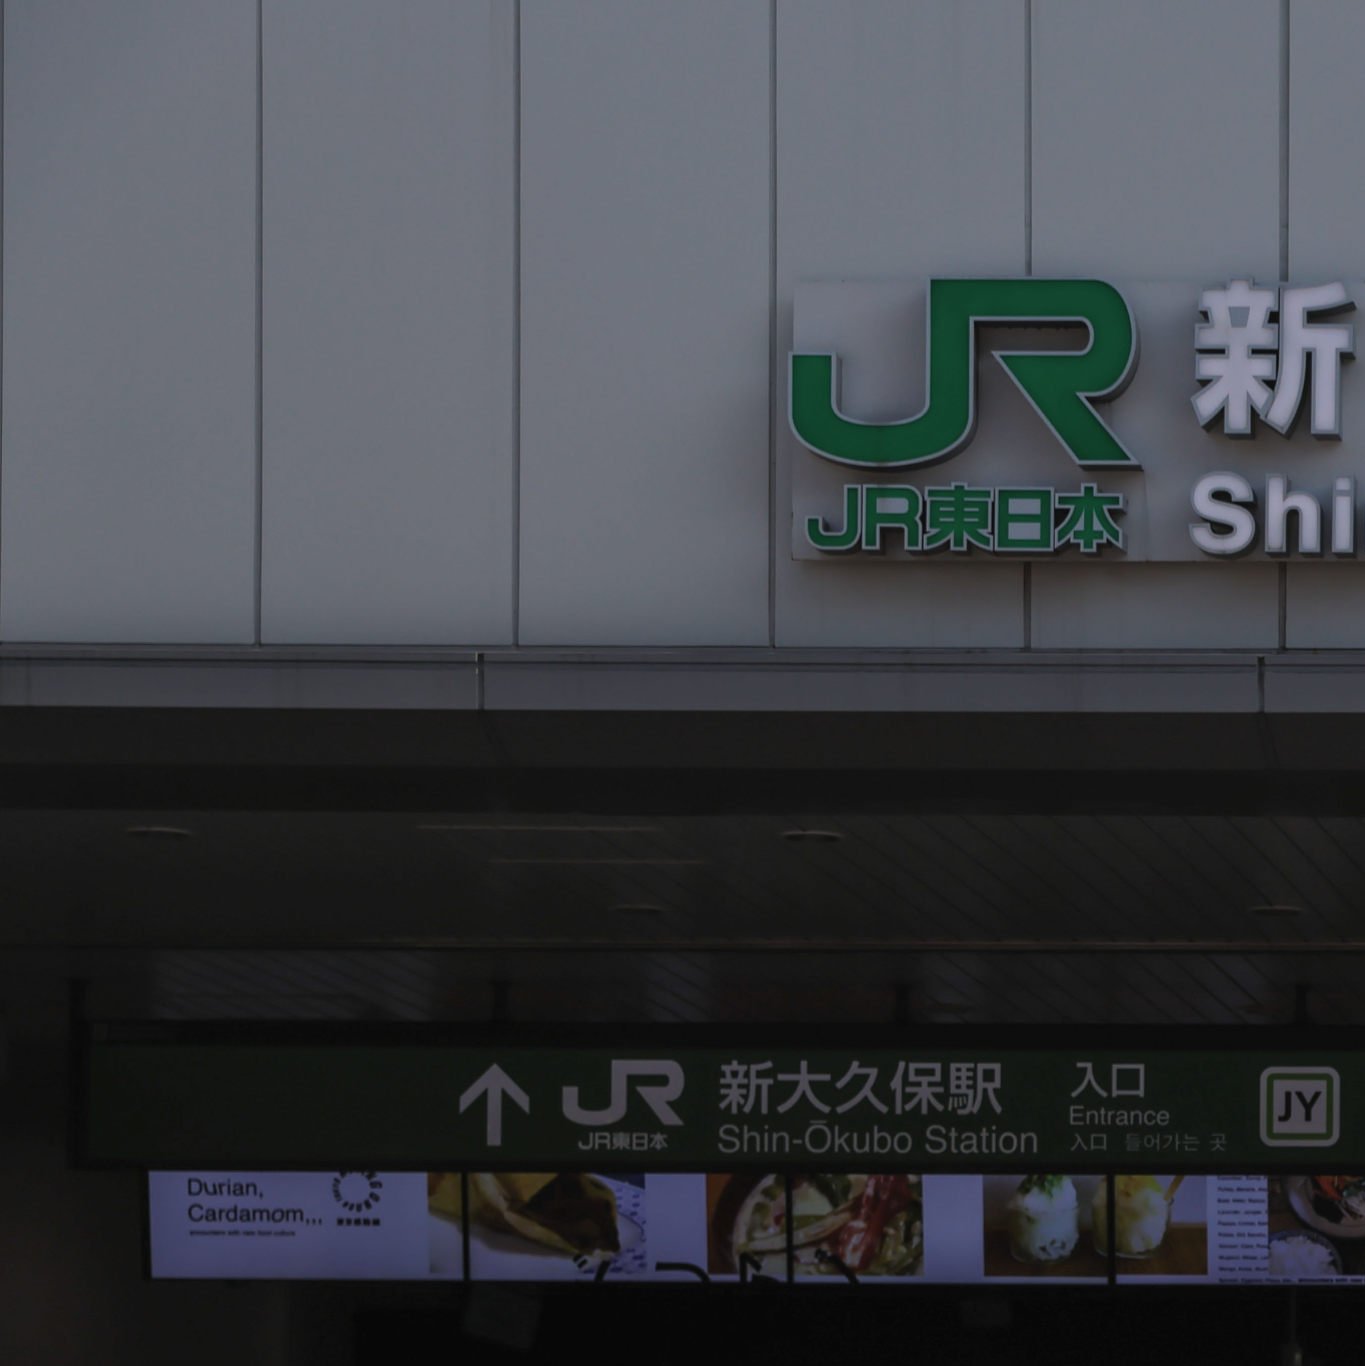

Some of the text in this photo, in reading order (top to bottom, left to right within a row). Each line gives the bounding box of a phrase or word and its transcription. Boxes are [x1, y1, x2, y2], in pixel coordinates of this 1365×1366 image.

[789, 278, 1141, 472] JR
[806, 483, 1124, 553] JR東日本
[562, 1060, 685, 1125] JR
[718, 1060, 1003, 1115] 新大久保駅
[1070, 1061, 1146, 1098] 入口
[1069, 1105, 1171, 1126] Entrance
[1276, 1090, 1322, 1123] JY
[577, 1132, 669, 1151] JR東日本
[718, 1120, 1038, 1154] Shin-Ōkubo Station
[1070, 1134, 1108, 1152] 入口
[1124, 1132, 1228, 1152] 들어가는 곳
[187, 1177, 265, 1200] Durian,
